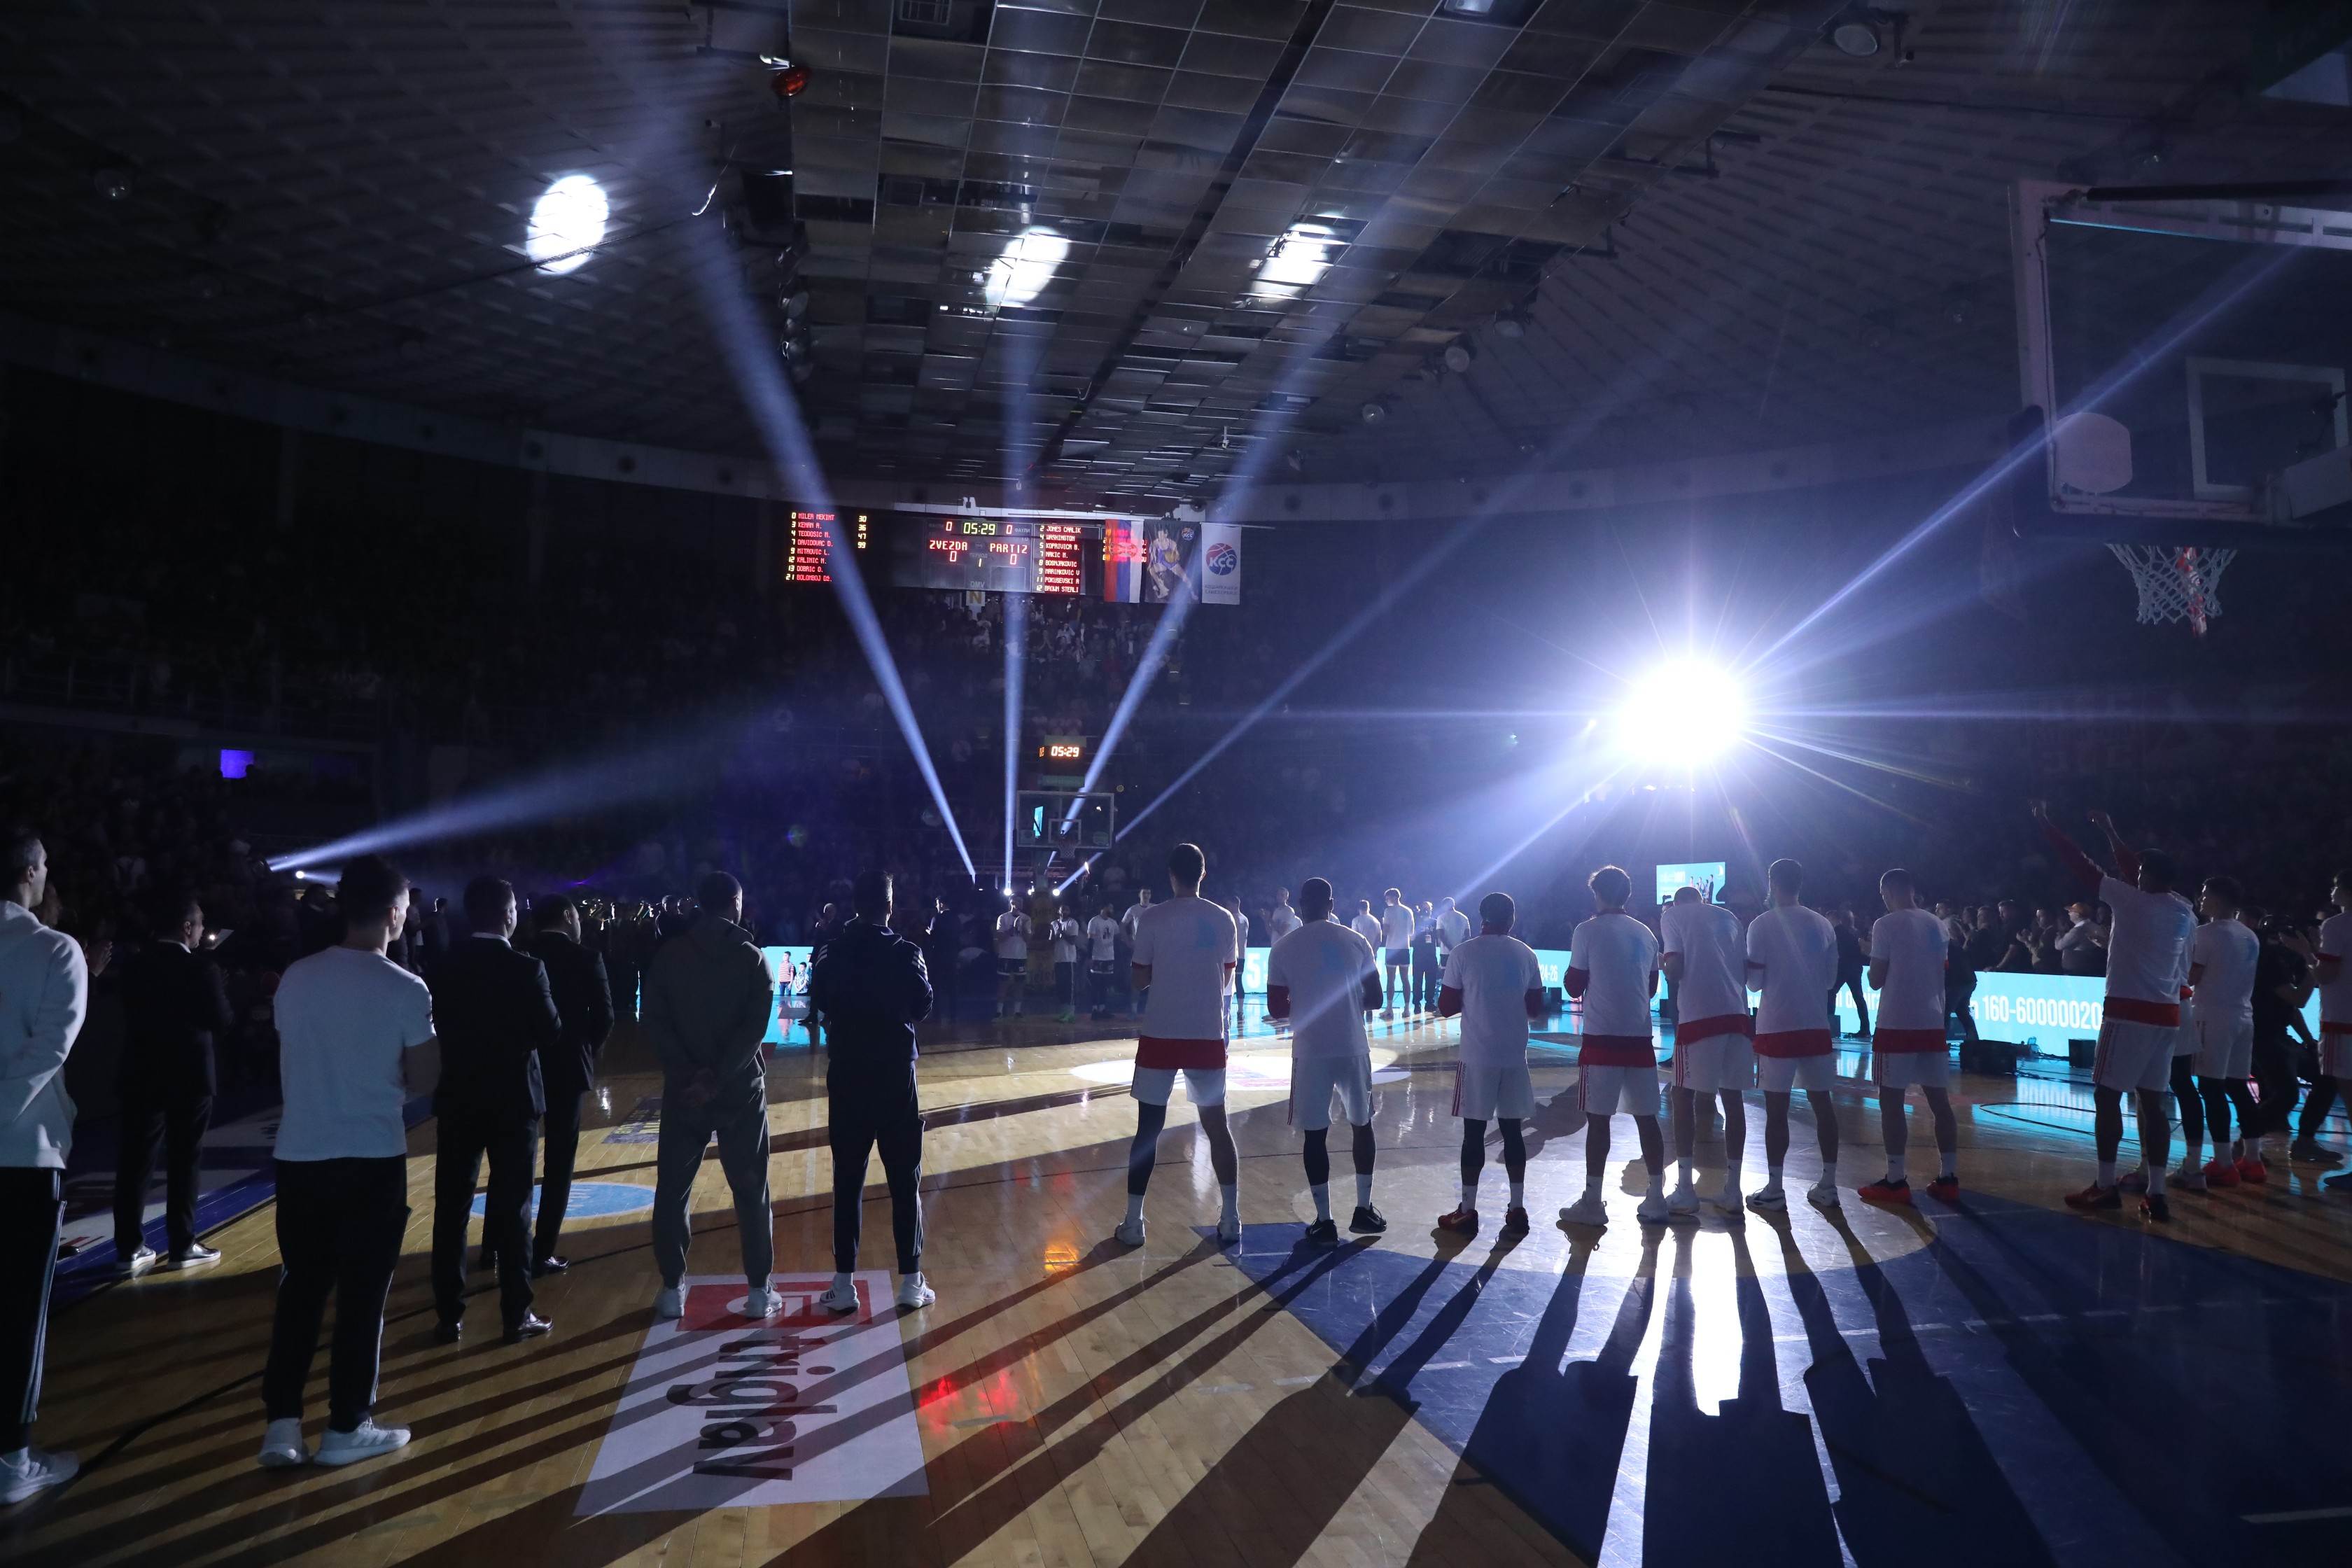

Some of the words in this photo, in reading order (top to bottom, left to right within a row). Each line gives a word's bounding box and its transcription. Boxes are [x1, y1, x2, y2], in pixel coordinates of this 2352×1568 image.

[946, 522, 953, 531] 0
[963, 522, 995, 536] 05:29
[1006, 525, 1013, 535] 0
[930, 540, 967, 551] ZVEZDA
[990, 543, 1028, 554] PARTIZ
[950, 551, 957, 562] 0
[1009, 554, 1017, 565] 0
[979, 558, 982, 568] 1
[1051, 746, 1079, 757] 05:29
[1246, 953, 1260, 988] 5
[666, 1336, 838, 1481] triglav
